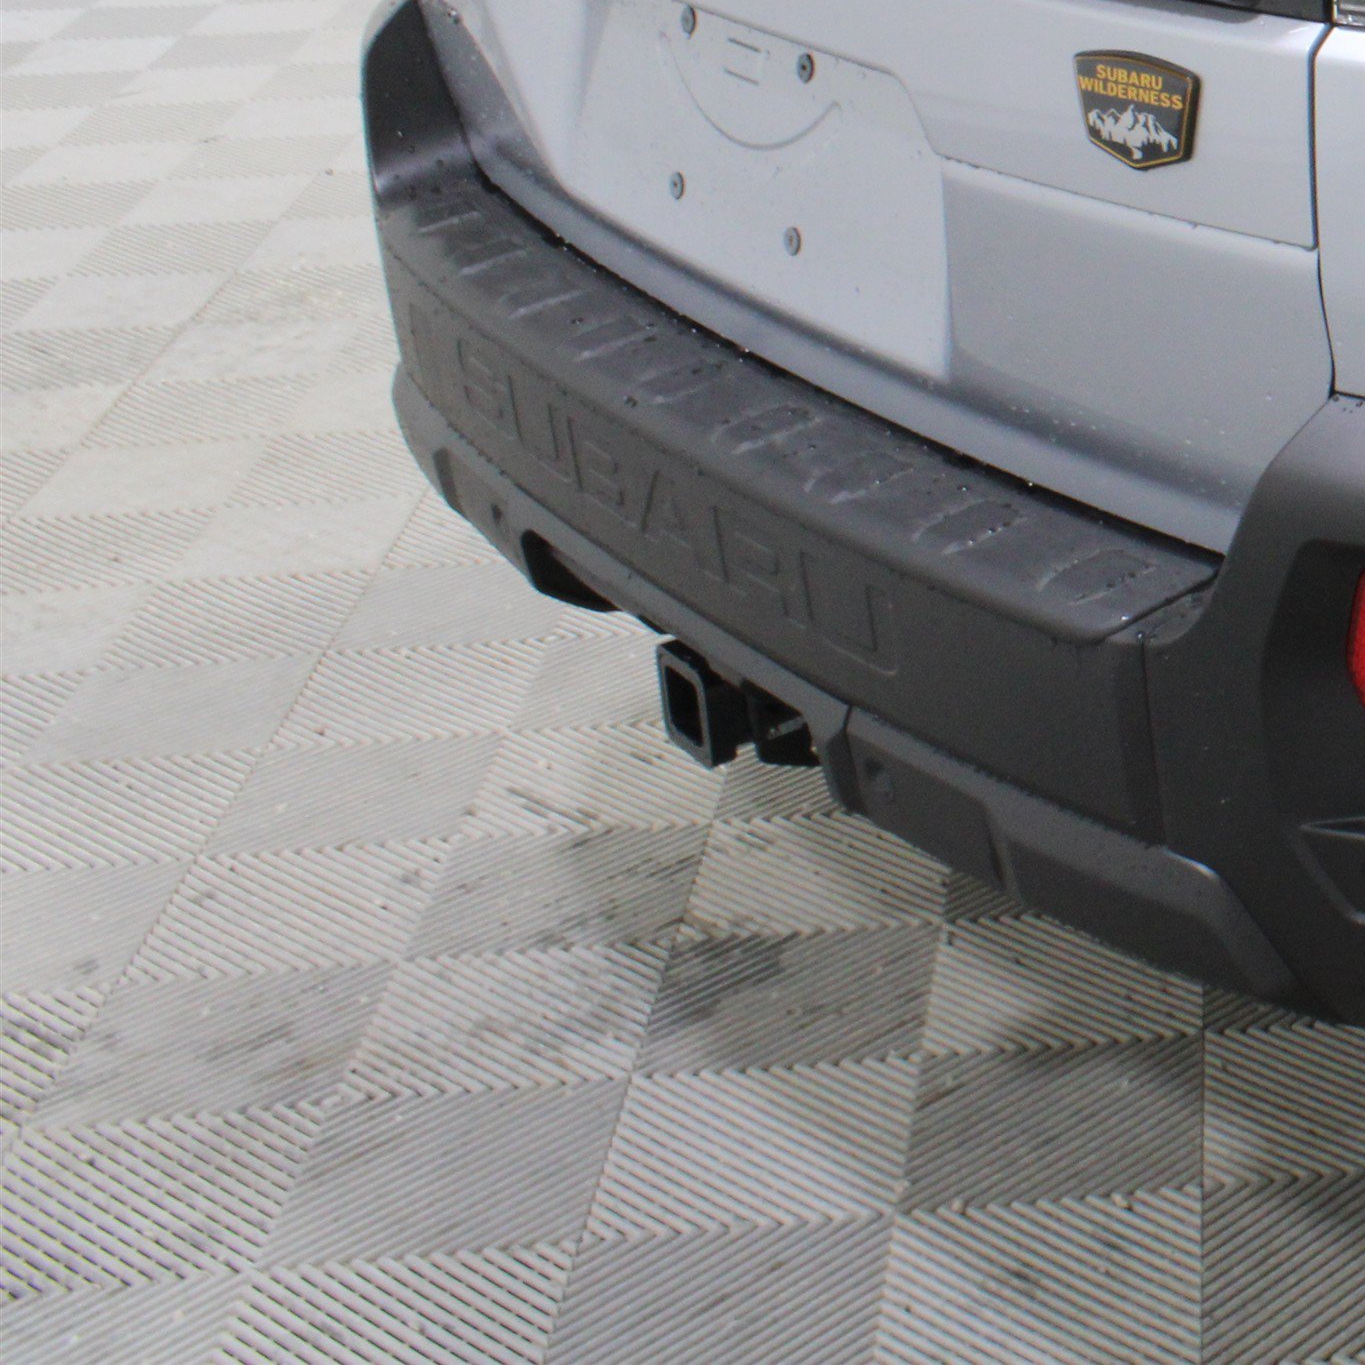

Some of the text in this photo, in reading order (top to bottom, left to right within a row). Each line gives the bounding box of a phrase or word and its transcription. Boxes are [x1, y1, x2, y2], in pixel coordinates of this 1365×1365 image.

[1079, 76, 1184, 110] WILDERNESS
[1096, 64, 1163, 90] SUBARU
[456, 337, 898, 677] SUBARU
